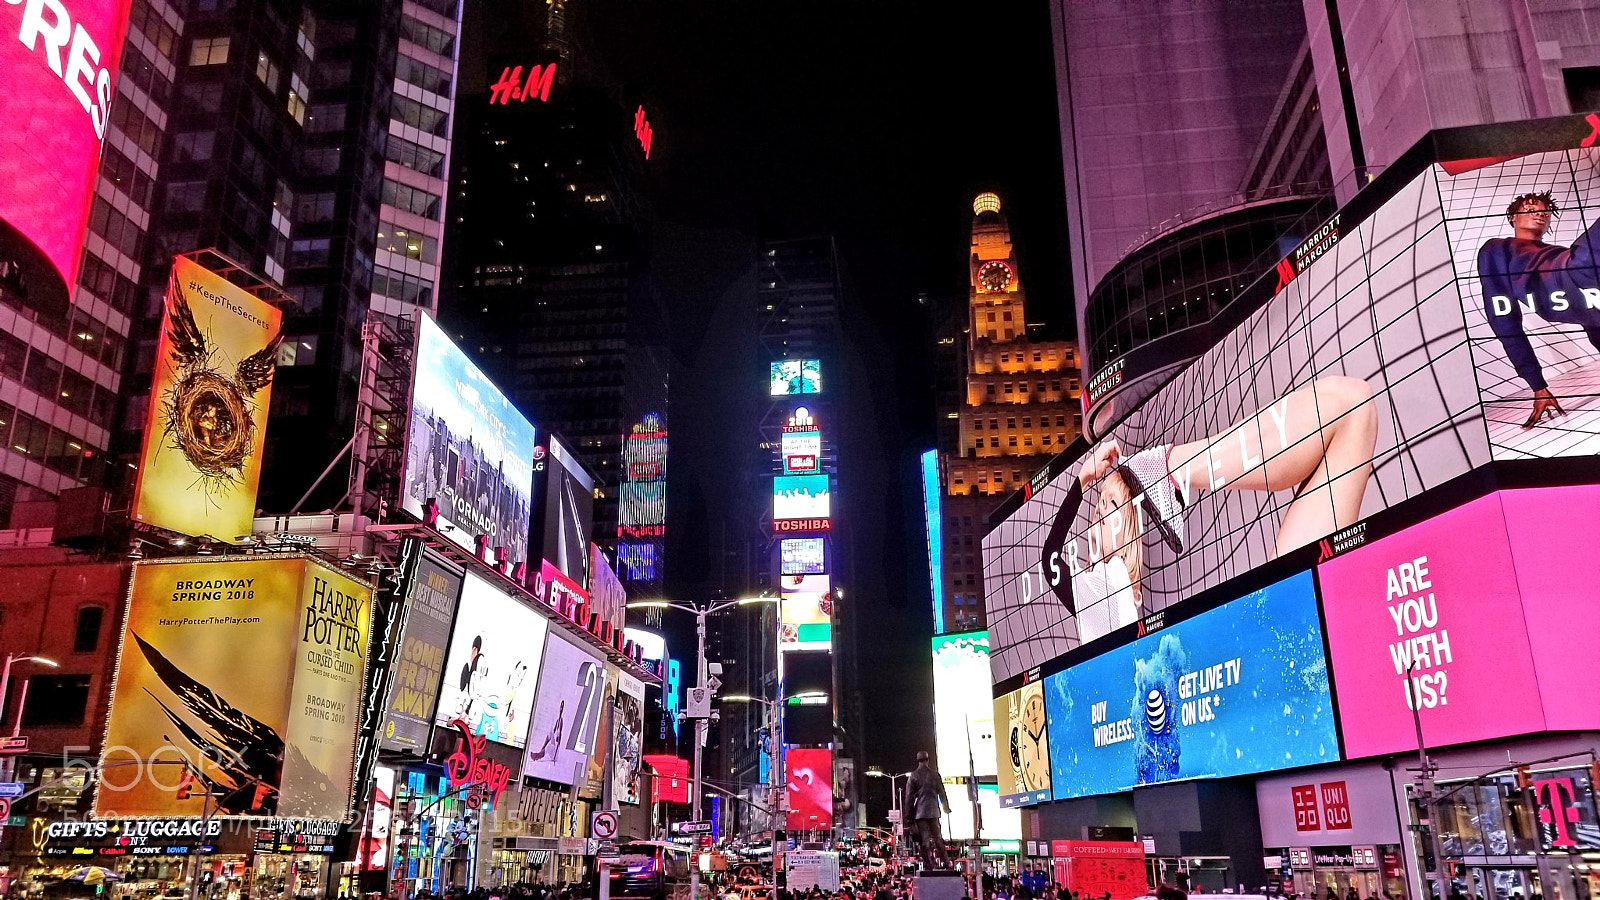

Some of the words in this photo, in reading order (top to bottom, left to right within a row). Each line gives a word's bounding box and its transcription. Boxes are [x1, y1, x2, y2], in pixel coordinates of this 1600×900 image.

[489, 63, 557, 105] H&M
[634, 104, 653, 160] H&M
[1296, 213, 1341, 260] MARRIOTT
[1298, 232, 1339, 272] MARQUIS
[188, 280, 270, 331] #KeepTheSecrets
[1089, 358, 1125, 391] MARRIOTT
[1090, 373, 1121, 403] MARQUIS
[782, 425, 819, 433] TOSHIBA
[451, 490, 497, 537] VORNADO
[773, 519, 831, 531] TOSHIBA
[1333, 522, 1367, 544] MARRIOTT
[1334, 534, 1365, 553] MARQUIS
[176, 578, 255, 590] BROADWAY
[1387, 555, 1432, 602] ARE
[172, 591, 222, 602] SPRING
[226, 590, 254, 600] 2018
[311, 576, 364, 628] HARRY
[159, 616, 260, 627] HarryPotterThePlay.com
[1388, 592, 1438, 637] YOU
[302, 606, 362, 659] POTTER
[307, 651, 333, 669] CURSED
[334, 659, 355, 676] CHILD
[404, 636, 443, 672] COME
[1388, 629, 1453, 676] WITH
[398, 659, 439, 697] FROM
[1178, 671, 1198, 700] GET
[1199, 664, 1224, 694] LIVE
[1224, 657, 1241, 687] TV
[1403, 670, 1449, 712] US?
[304, 706, 330, 721] SPRING
[331, 712, 345, 724] 2018
[306, 694, 346, 713] BROADWAY
[391, 686, 434, 719] AWAY
[1091, 700, 1107, 725] BUY
[1181, 700, 1197, 727] ON
[1093, 718, 1135, 748] WIRELESS.
[1323, 787, 1344, 805] UNI
[1326, 807, 1348, 827] QLO
[1534, 777, 1580, 847] T
[48, 821, 108, 838] GIFTS
[122, 820, 221, 837] LUGGAGE
[129, 836, 148, 847] NY
[269, 819, 296, 834] GIFTS
[300, 820, 338, 836] LUGGAGE
[132, 846, 162, 854] SONY
